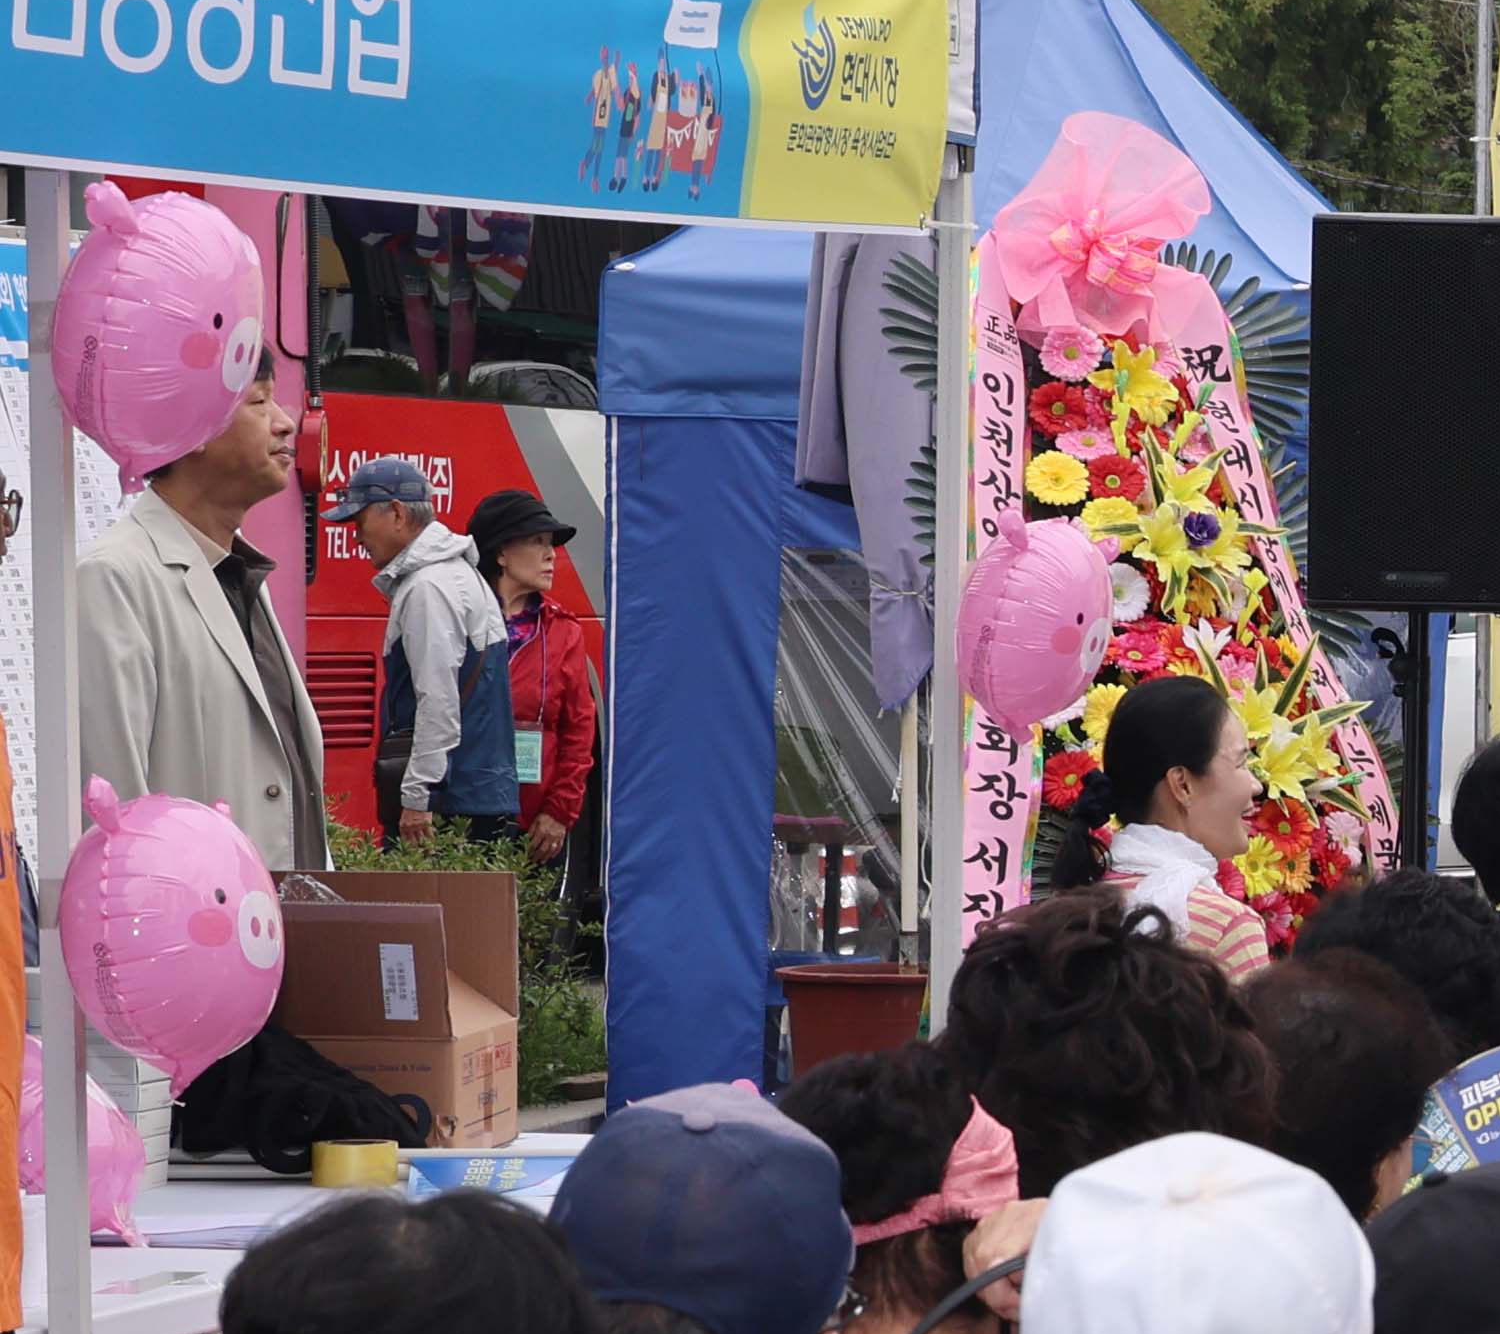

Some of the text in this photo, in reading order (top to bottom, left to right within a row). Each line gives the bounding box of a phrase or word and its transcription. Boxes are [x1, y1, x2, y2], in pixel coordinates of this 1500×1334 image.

[836, 15, 892, 43] JEMULPO
[840, 52, 899, 108] 현대시장
[1182, 343, 1233, 386] 祝
